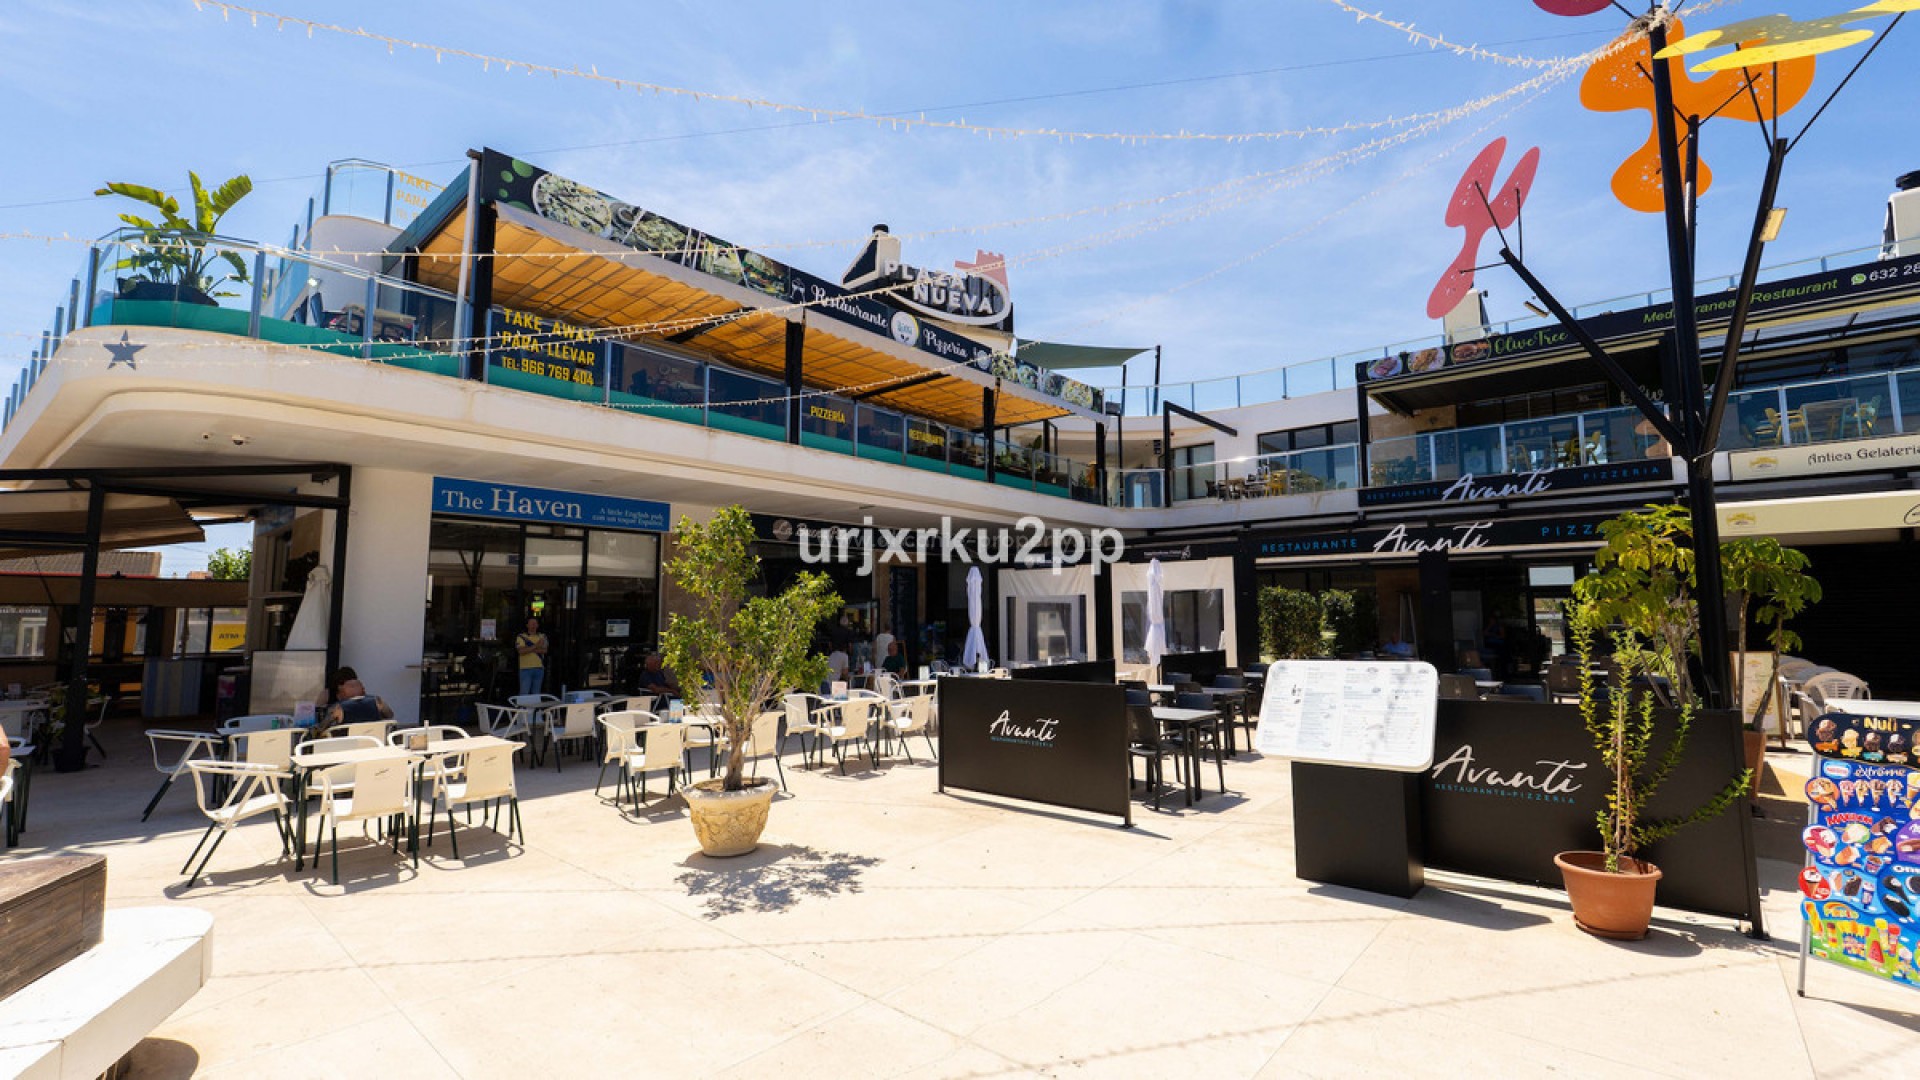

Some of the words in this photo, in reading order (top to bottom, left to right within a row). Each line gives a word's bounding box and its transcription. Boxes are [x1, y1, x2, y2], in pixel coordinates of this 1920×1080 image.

[884, 259, 966, 291] PLAZA
[1869, 267, 1898, 281] 632
[913, 281, 993, 315] NUEVA
[1750, 280, 1839, 303] Restaurant
[503, 308, 543, 331] TAKE
[552, 321, 595, 344] AWAY
[502, 331, 539, 352] PARA
[547, 342, 595, 366] LLEVAR
[923, 327, 969, 358] Pizzeria
[521, 358, 545, 375] 966
[548, 364, 570, 381] 769
[572, 368, 595, 386] 404
[1441, 466, 1555, 502] Avanti
[1583, 466, 1660, 481] PIZZERIA
[441, 489, 484, 511] The
[489, 487, 582, 520] Haven
[1262, 538, 1358, 554] RESTAURANTE
[1373, 522, 1494, 554] Avanti
[989, 709, 1059, 741] Avanti
[1431, 744, 1588, 794] Avanti
